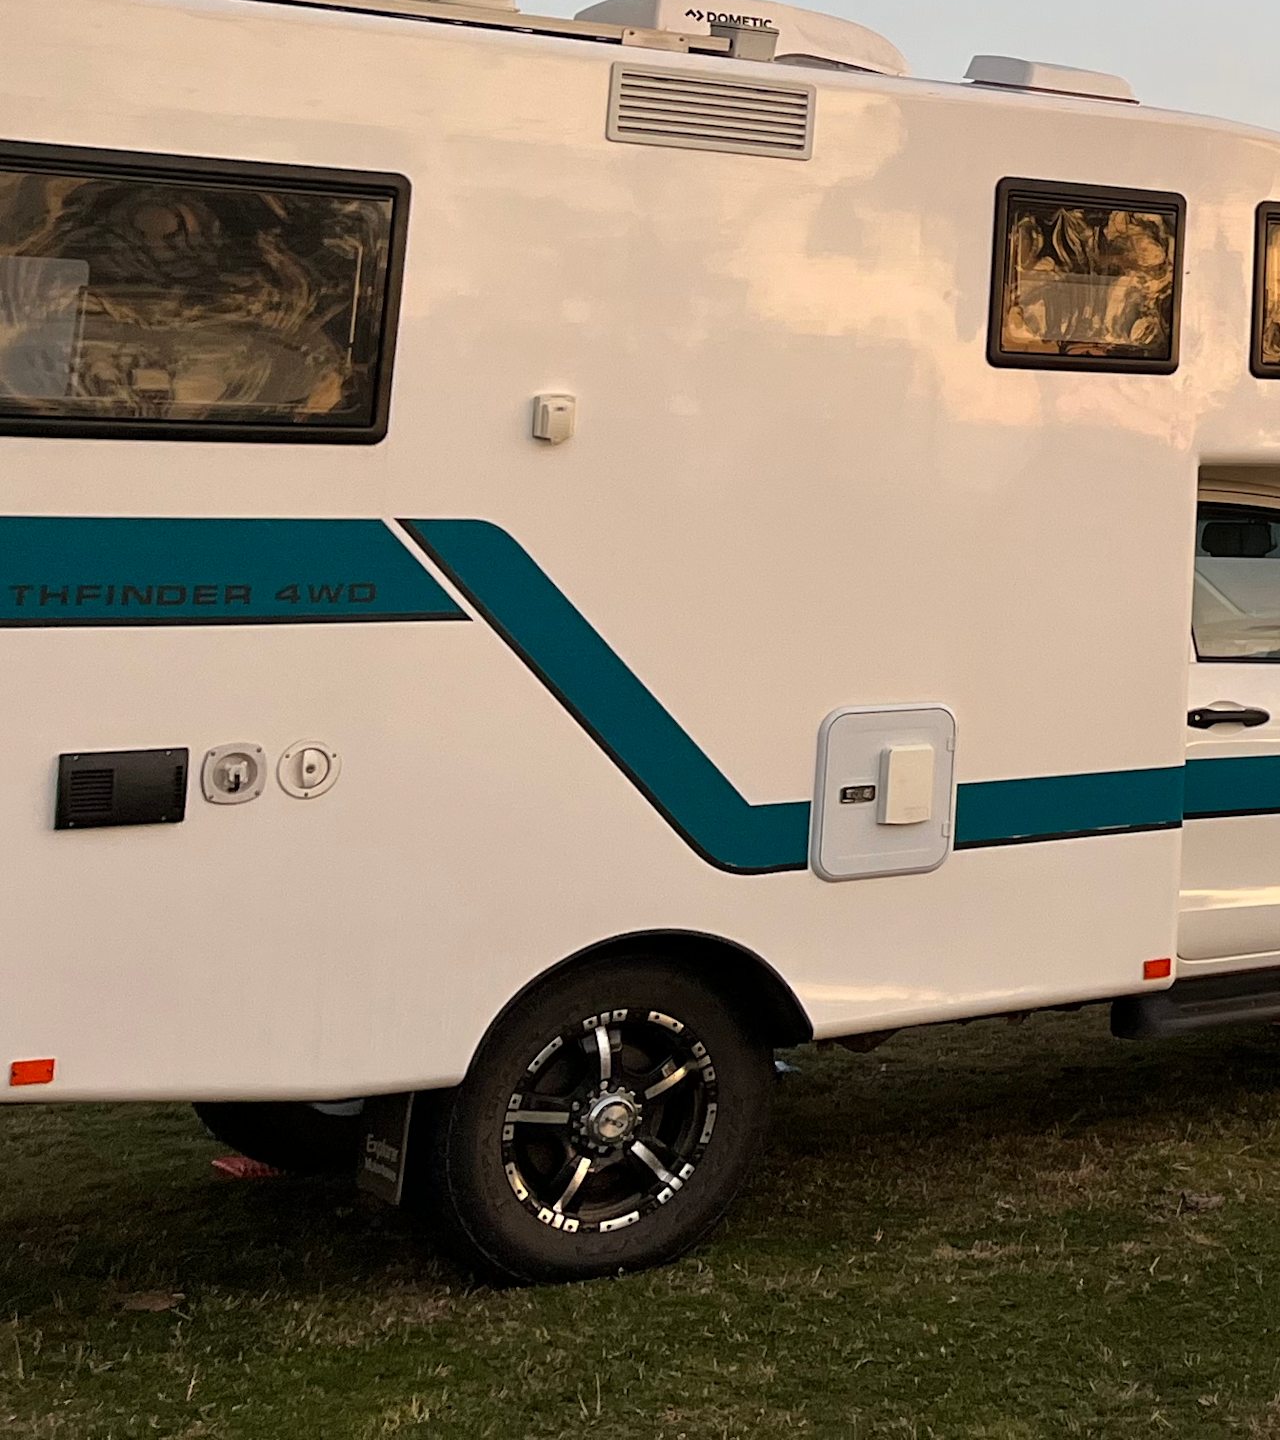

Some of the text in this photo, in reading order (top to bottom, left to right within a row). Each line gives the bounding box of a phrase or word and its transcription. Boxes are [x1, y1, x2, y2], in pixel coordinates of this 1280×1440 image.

[707, 11, 772, 28] DOMETIC
[9, 582, 377, 606] THFINDER 4WD
